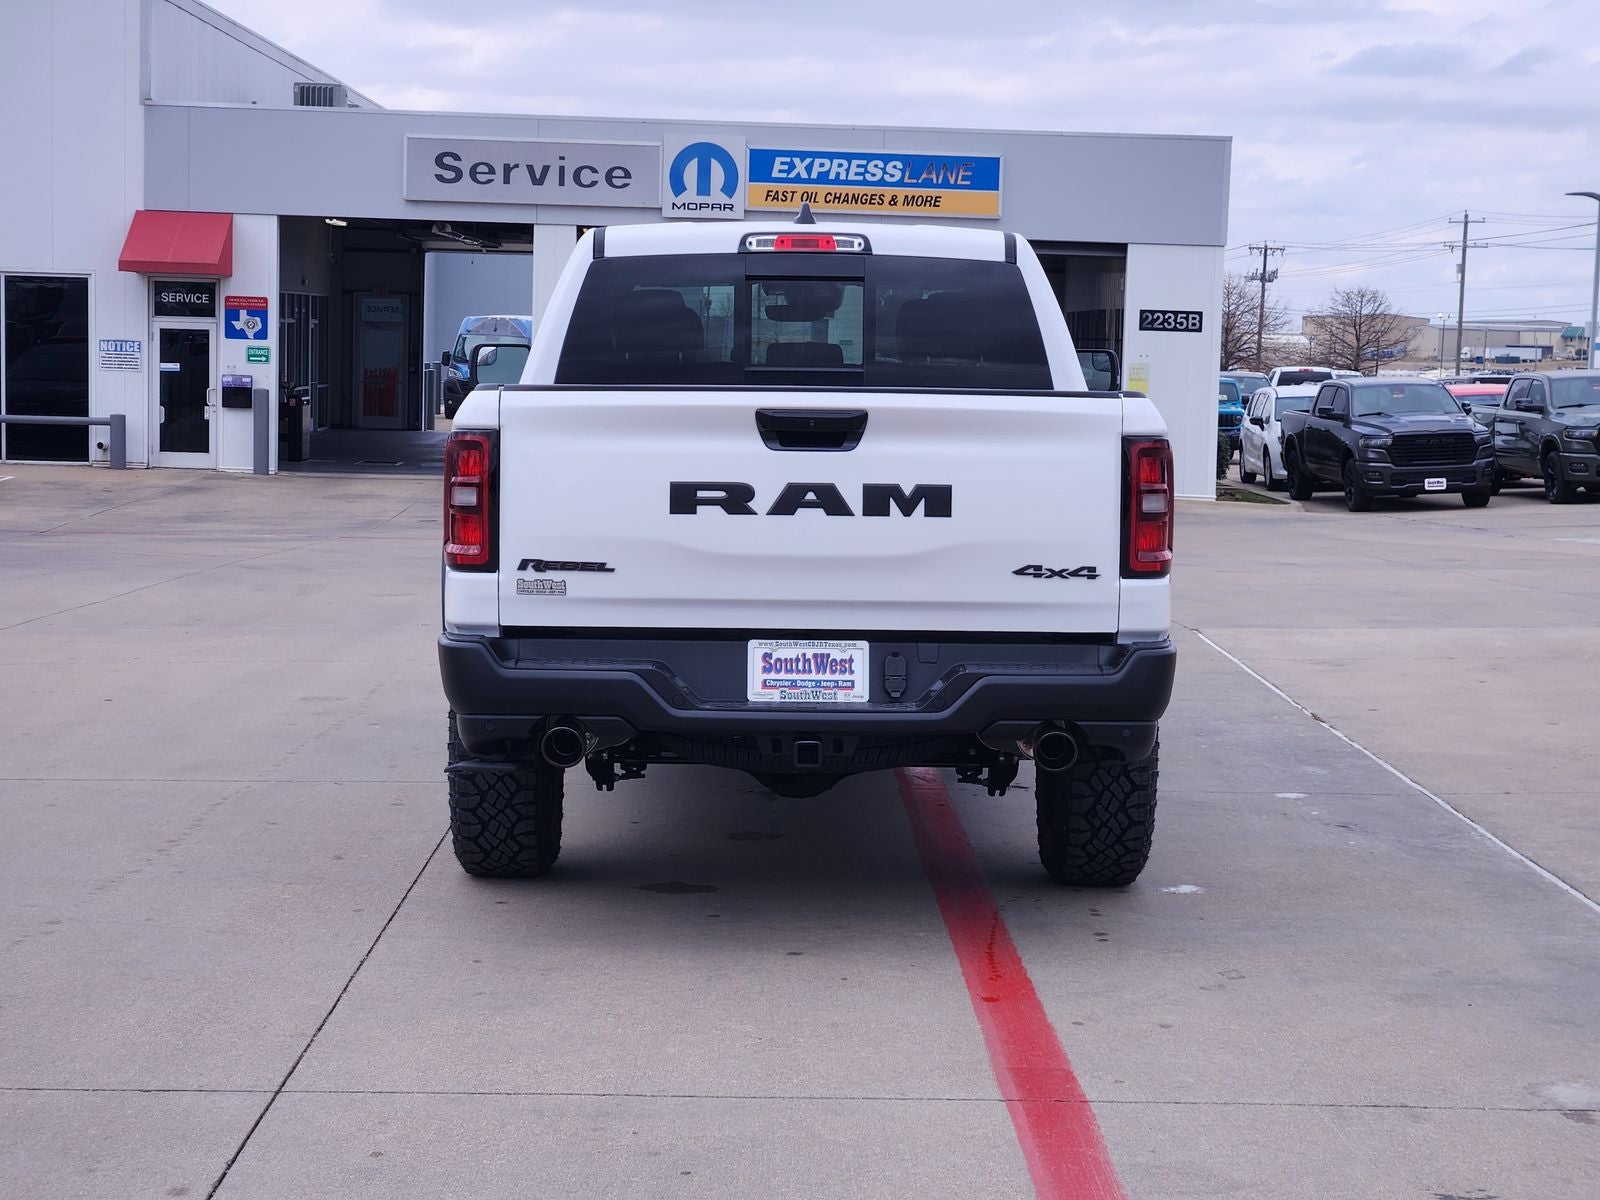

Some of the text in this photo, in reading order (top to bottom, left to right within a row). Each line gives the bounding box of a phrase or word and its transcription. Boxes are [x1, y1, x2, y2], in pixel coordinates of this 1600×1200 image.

[434, 151, 632, 190] Service
[764, 190, 942, 208] FAST OIL CHANGES & MORE
[671, 202, 736, 212] MOPAR
[161, 292, 210, 304] SERVICE
[1142, 312, 1201, 330] 2235B
[100, 340, 141, 352] NOTICE
[248, 348, 269, 356] ENTRANCE
[669, 481, 953, 518] RAM
[516, 558, 616, 573] REBEL
[1011, 564, 1102, 580] 4x4
[517, 579, 566, 590] SouthWest
[761, 651, 855, 676] SouthWest
[766, 680, 791, 688] Chrysler
[797, 680, 816, 688] Dodge
[820, 680, 835, 688] Jeep
[780, 689, 838, 701] SouthWest
